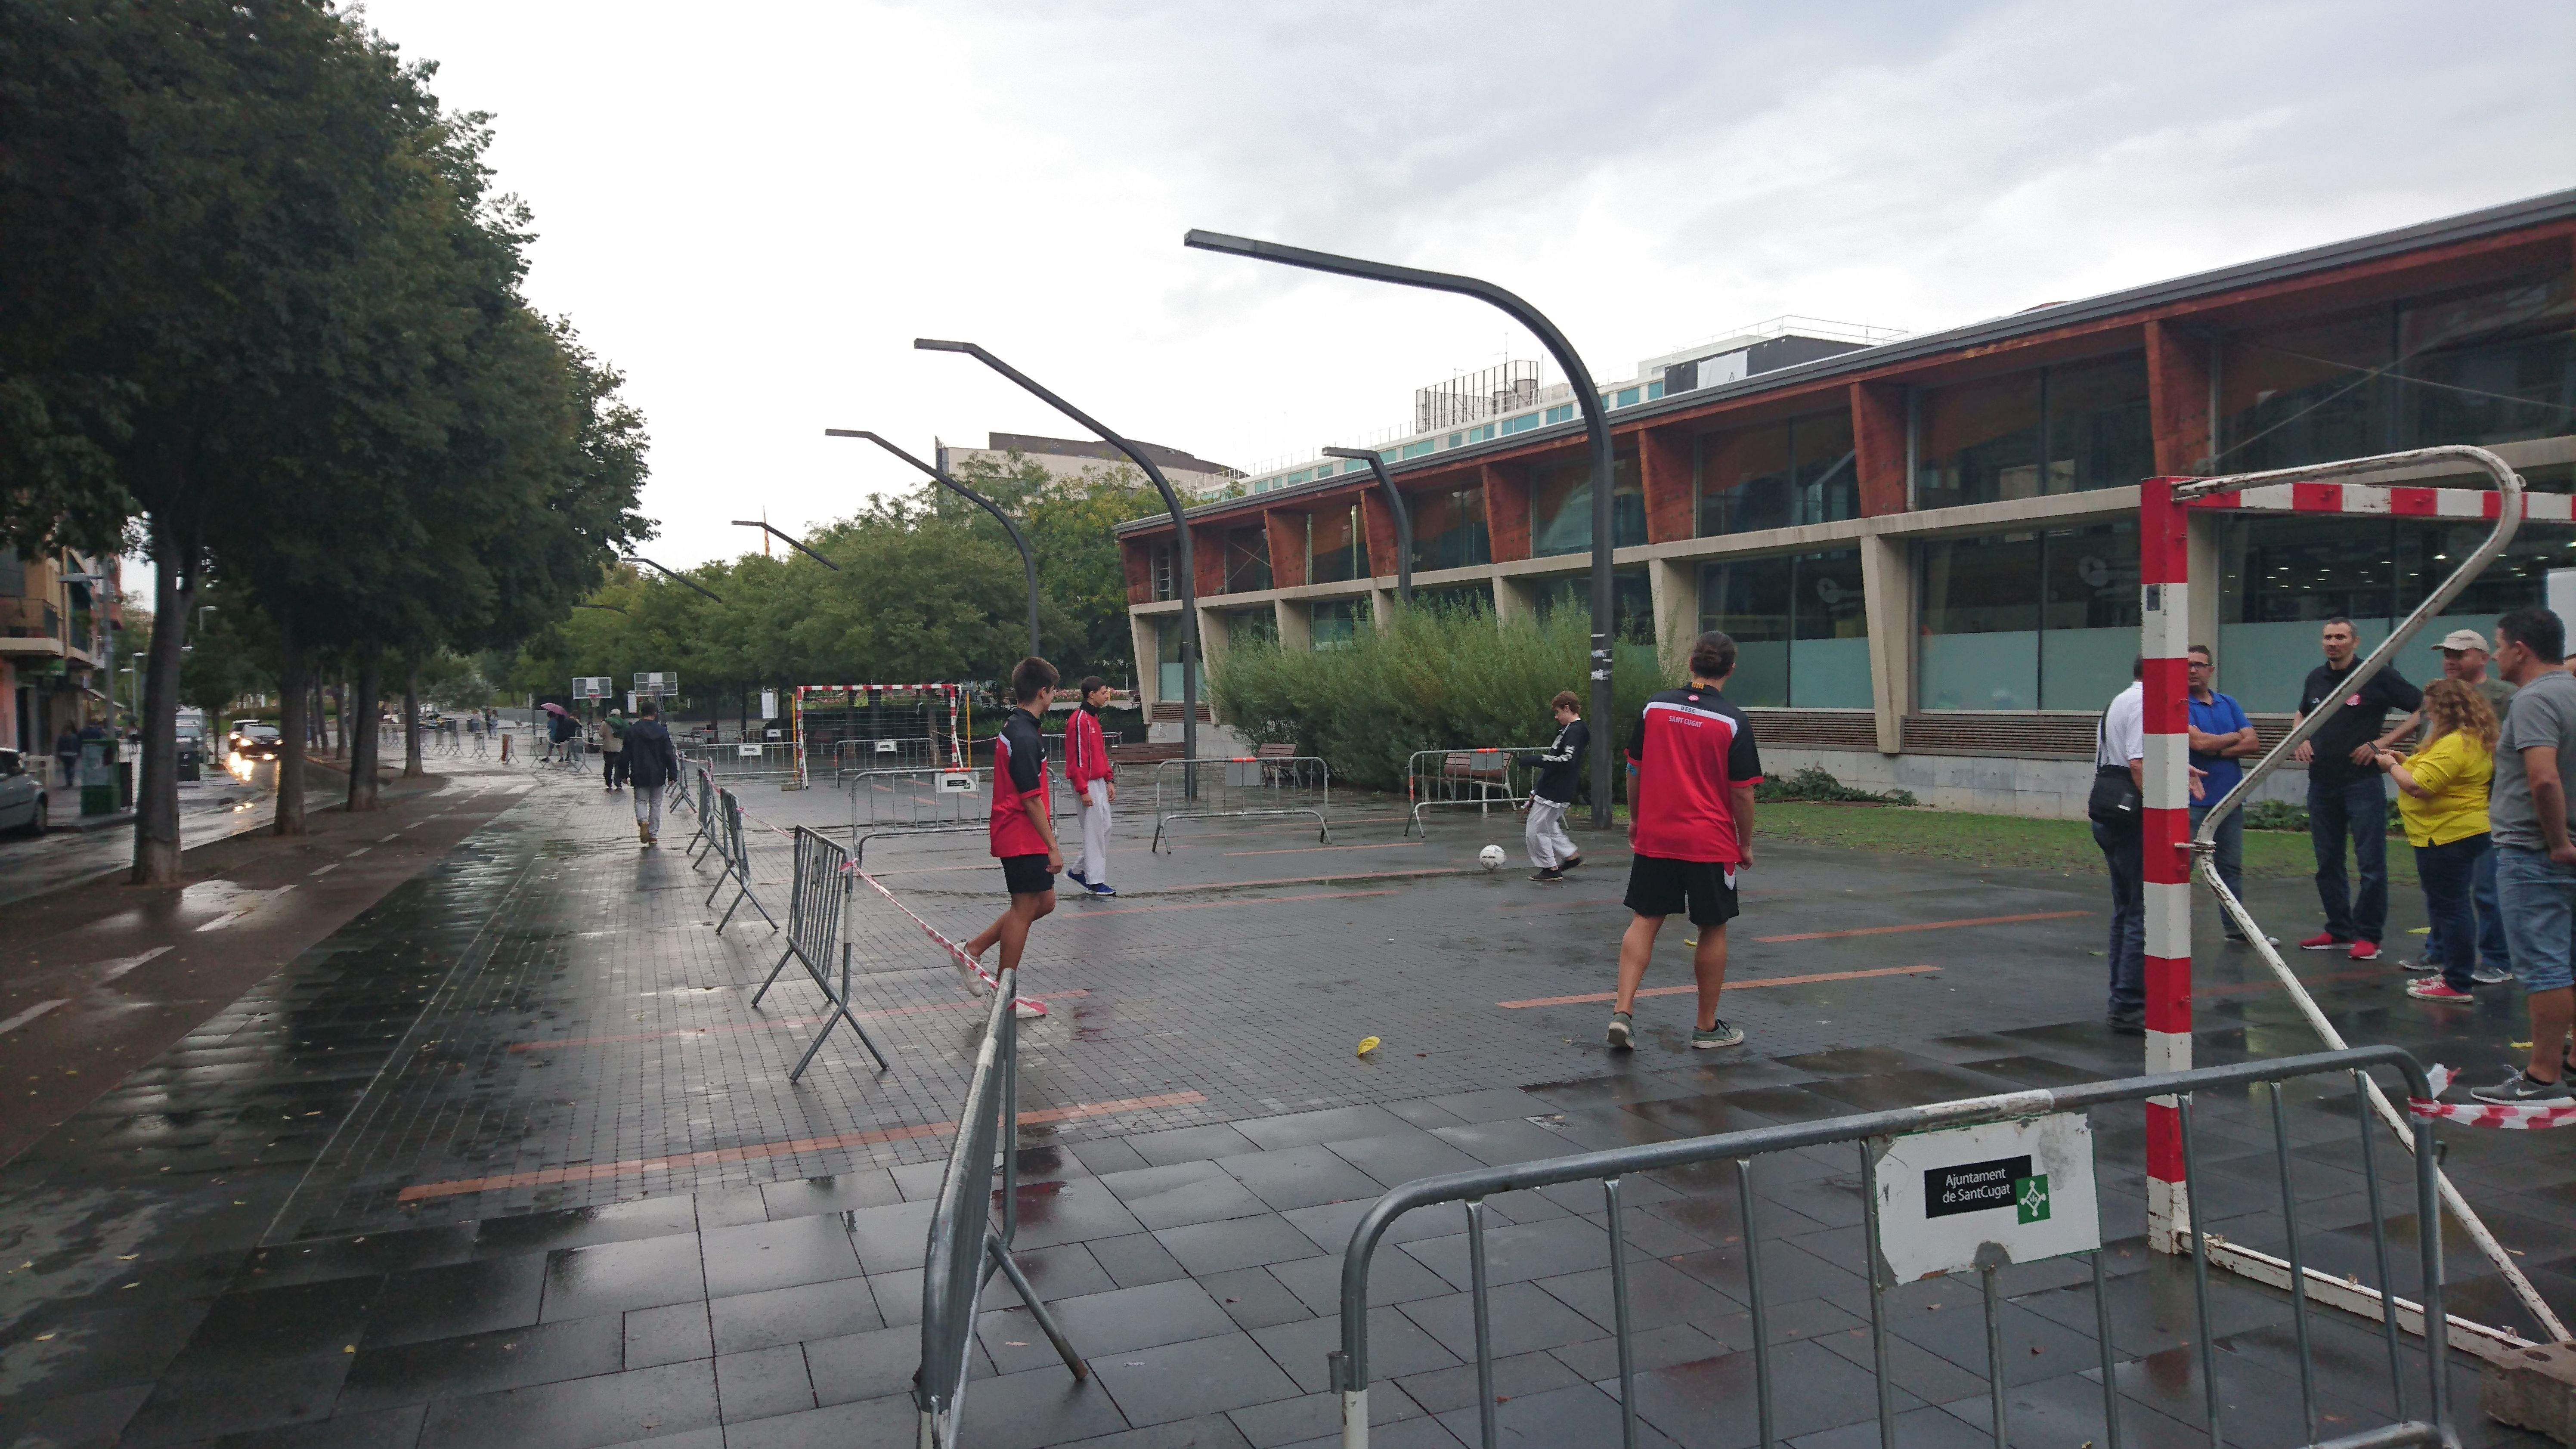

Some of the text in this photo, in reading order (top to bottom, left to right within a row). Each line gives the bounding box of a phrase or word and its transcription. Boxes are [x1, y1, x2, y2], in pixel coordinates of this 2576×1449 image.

[1684, 718, 1703, 728] CUGAT
[1945, 1168, 2006, 1189] Ajuntament
[1942, 1190, 1956, 1203] de
